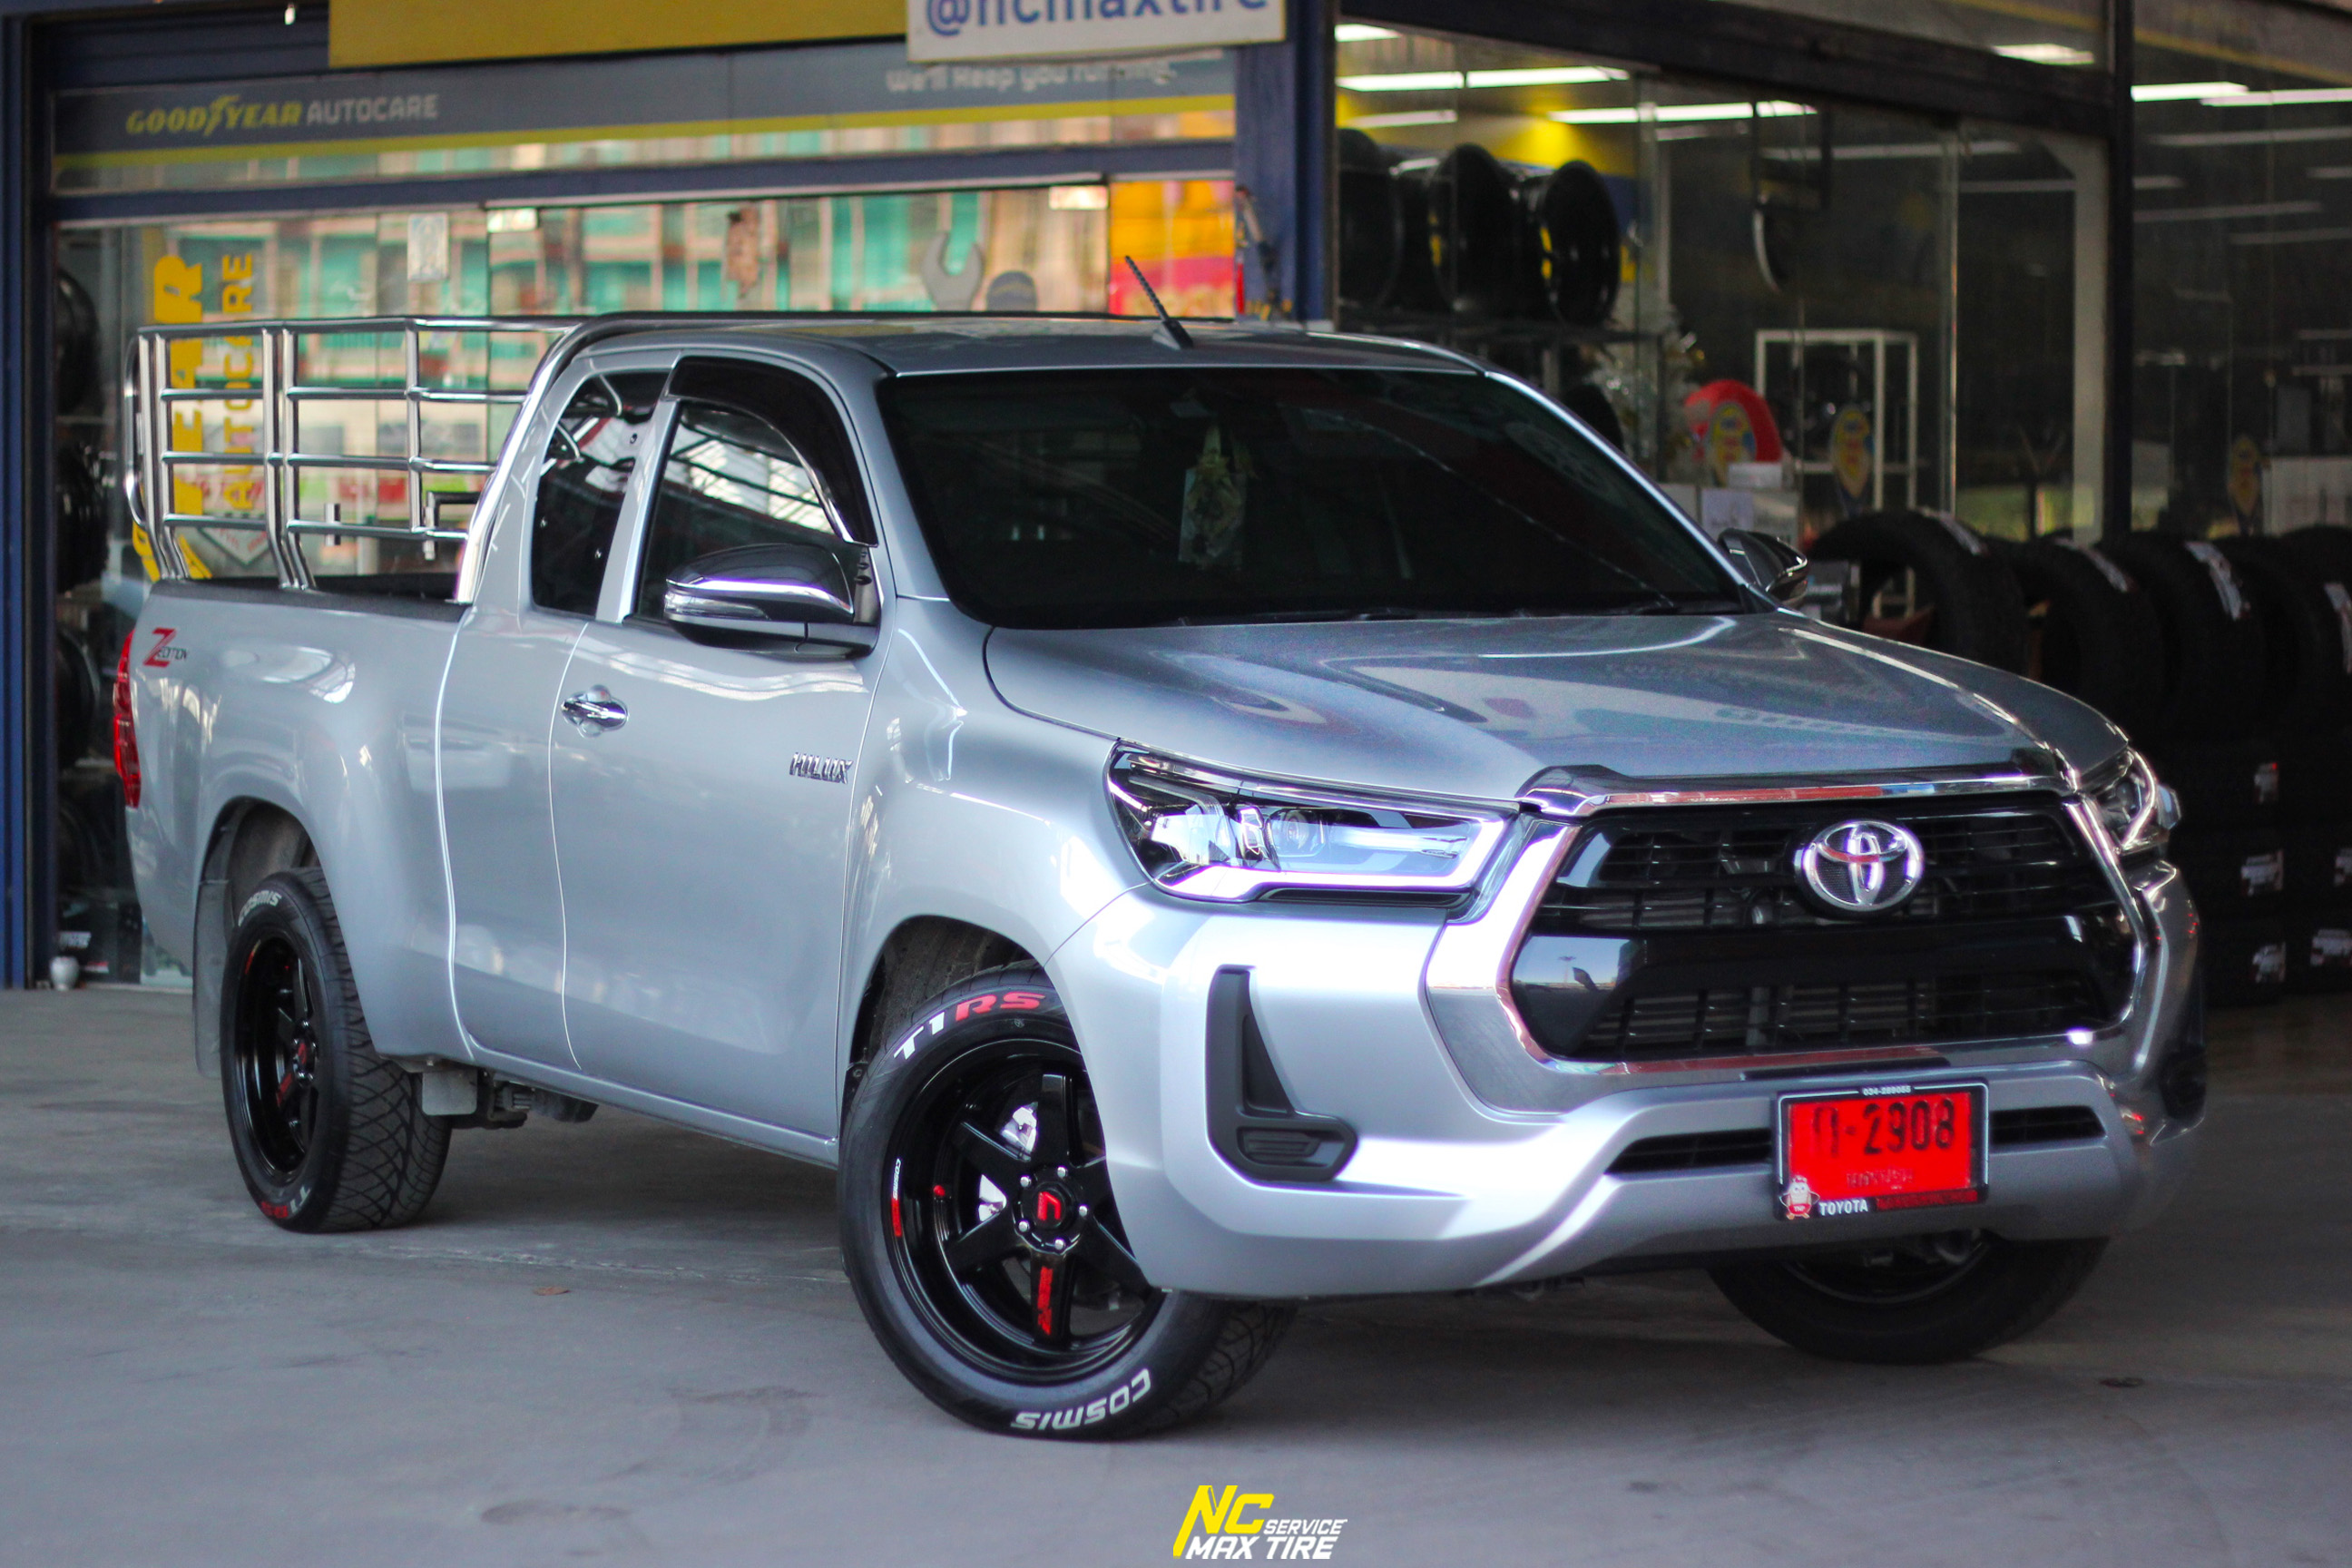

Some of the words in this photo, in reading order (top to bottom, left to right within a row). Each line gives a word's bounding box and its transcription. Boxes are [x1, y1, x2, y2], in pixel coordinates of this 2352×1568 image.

[125, 94, 302, 137] GOODYEAR
[307, 94, 439, 126] AUTOCARE
[789, 751, 854, 785] HILUX
[1819, 1198, 1869, 1217] TOYOTA
[1010, 1367, 1152, 1431] COSMIS
